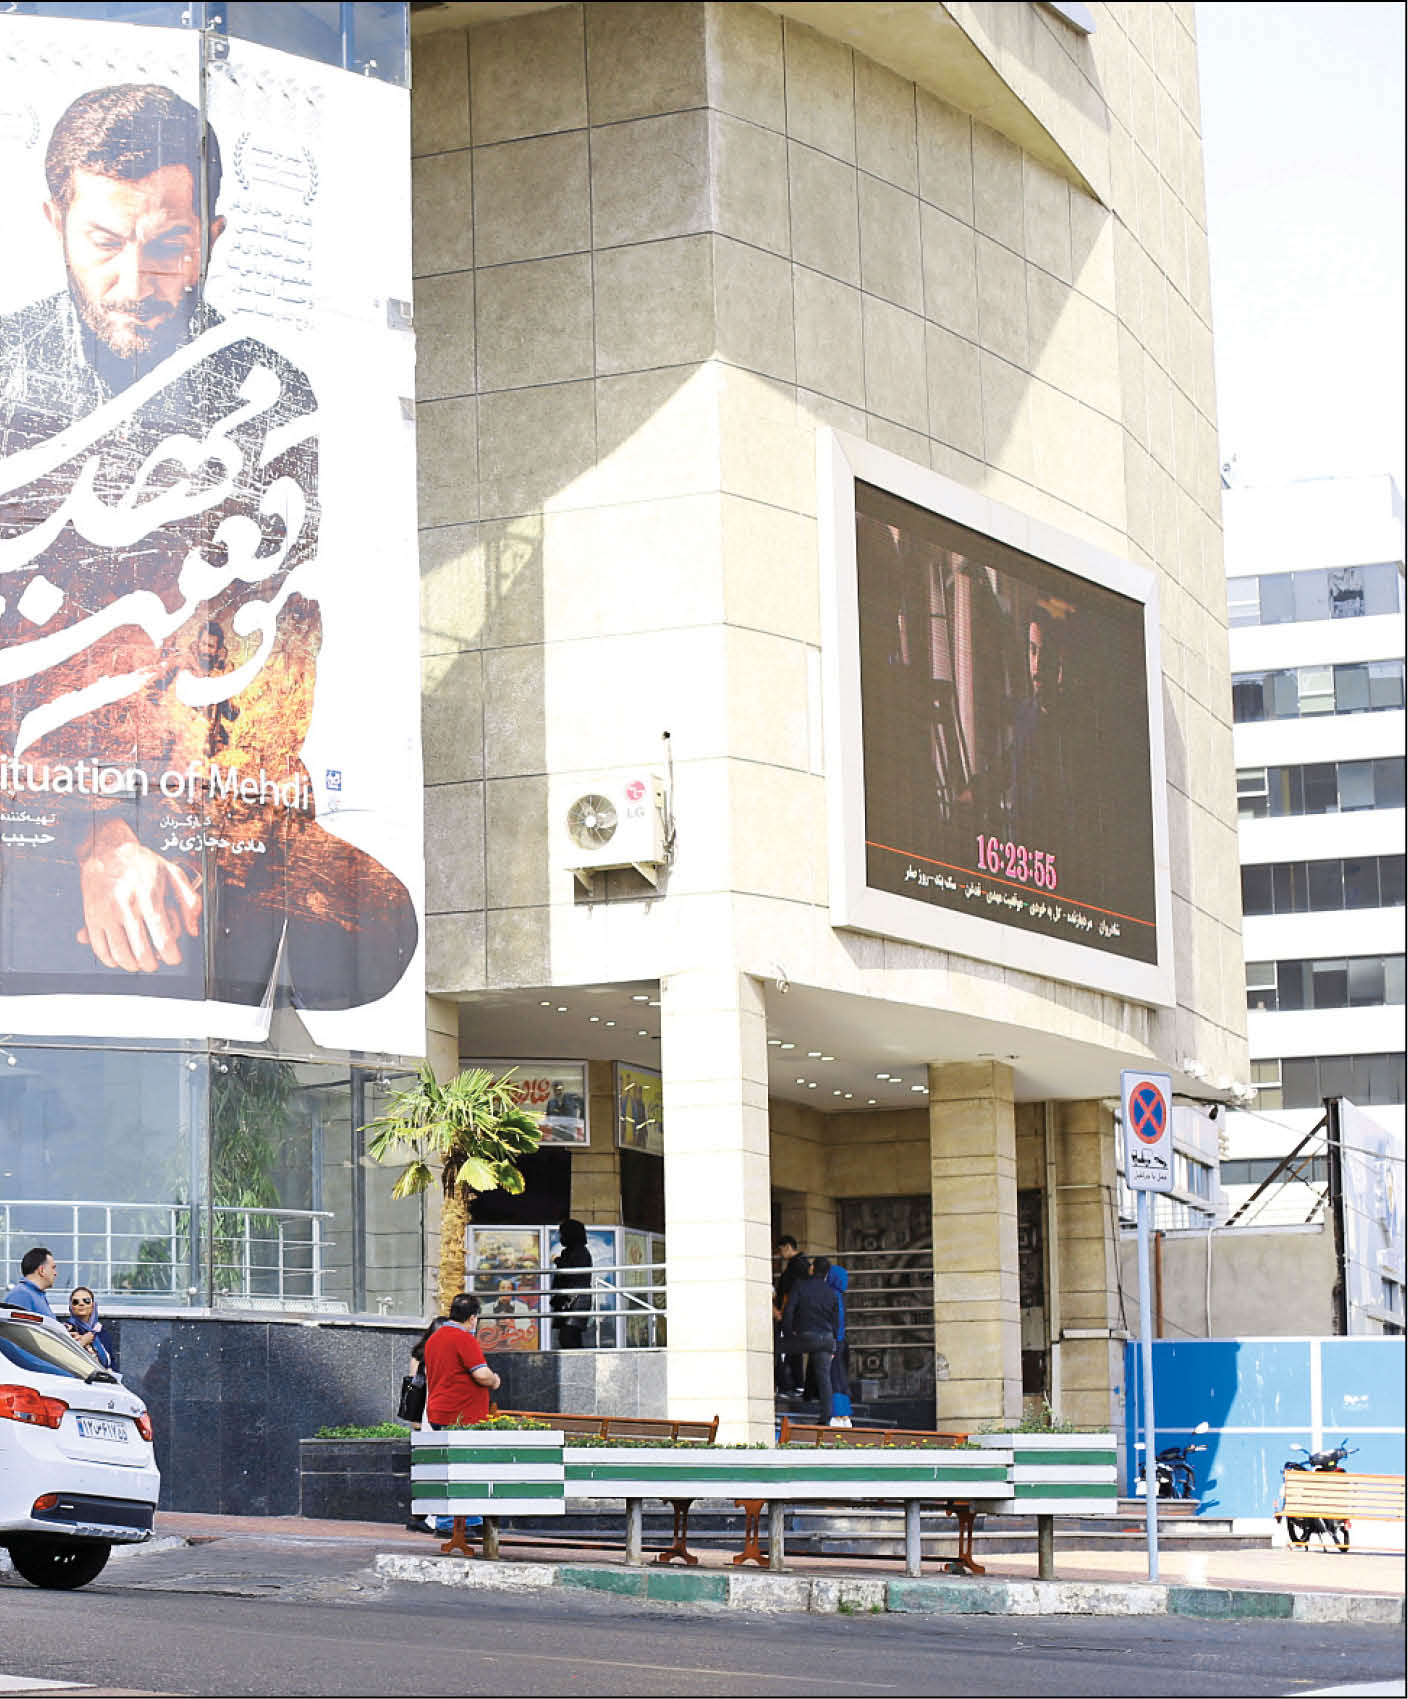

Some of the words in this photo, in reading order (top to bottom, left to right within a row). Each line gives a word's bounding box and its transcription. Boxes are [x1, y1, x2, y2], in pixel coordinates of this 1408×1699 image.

[160, 761, 203, 801] of
[209, 764, 311, 810] Mehdi
[626, 807, 645, 818] LG
[1, 831, 56, 847] حبیب
[232, 838, 267, 854] هادی
[976, 833, 1057, 890] 16:23:55
